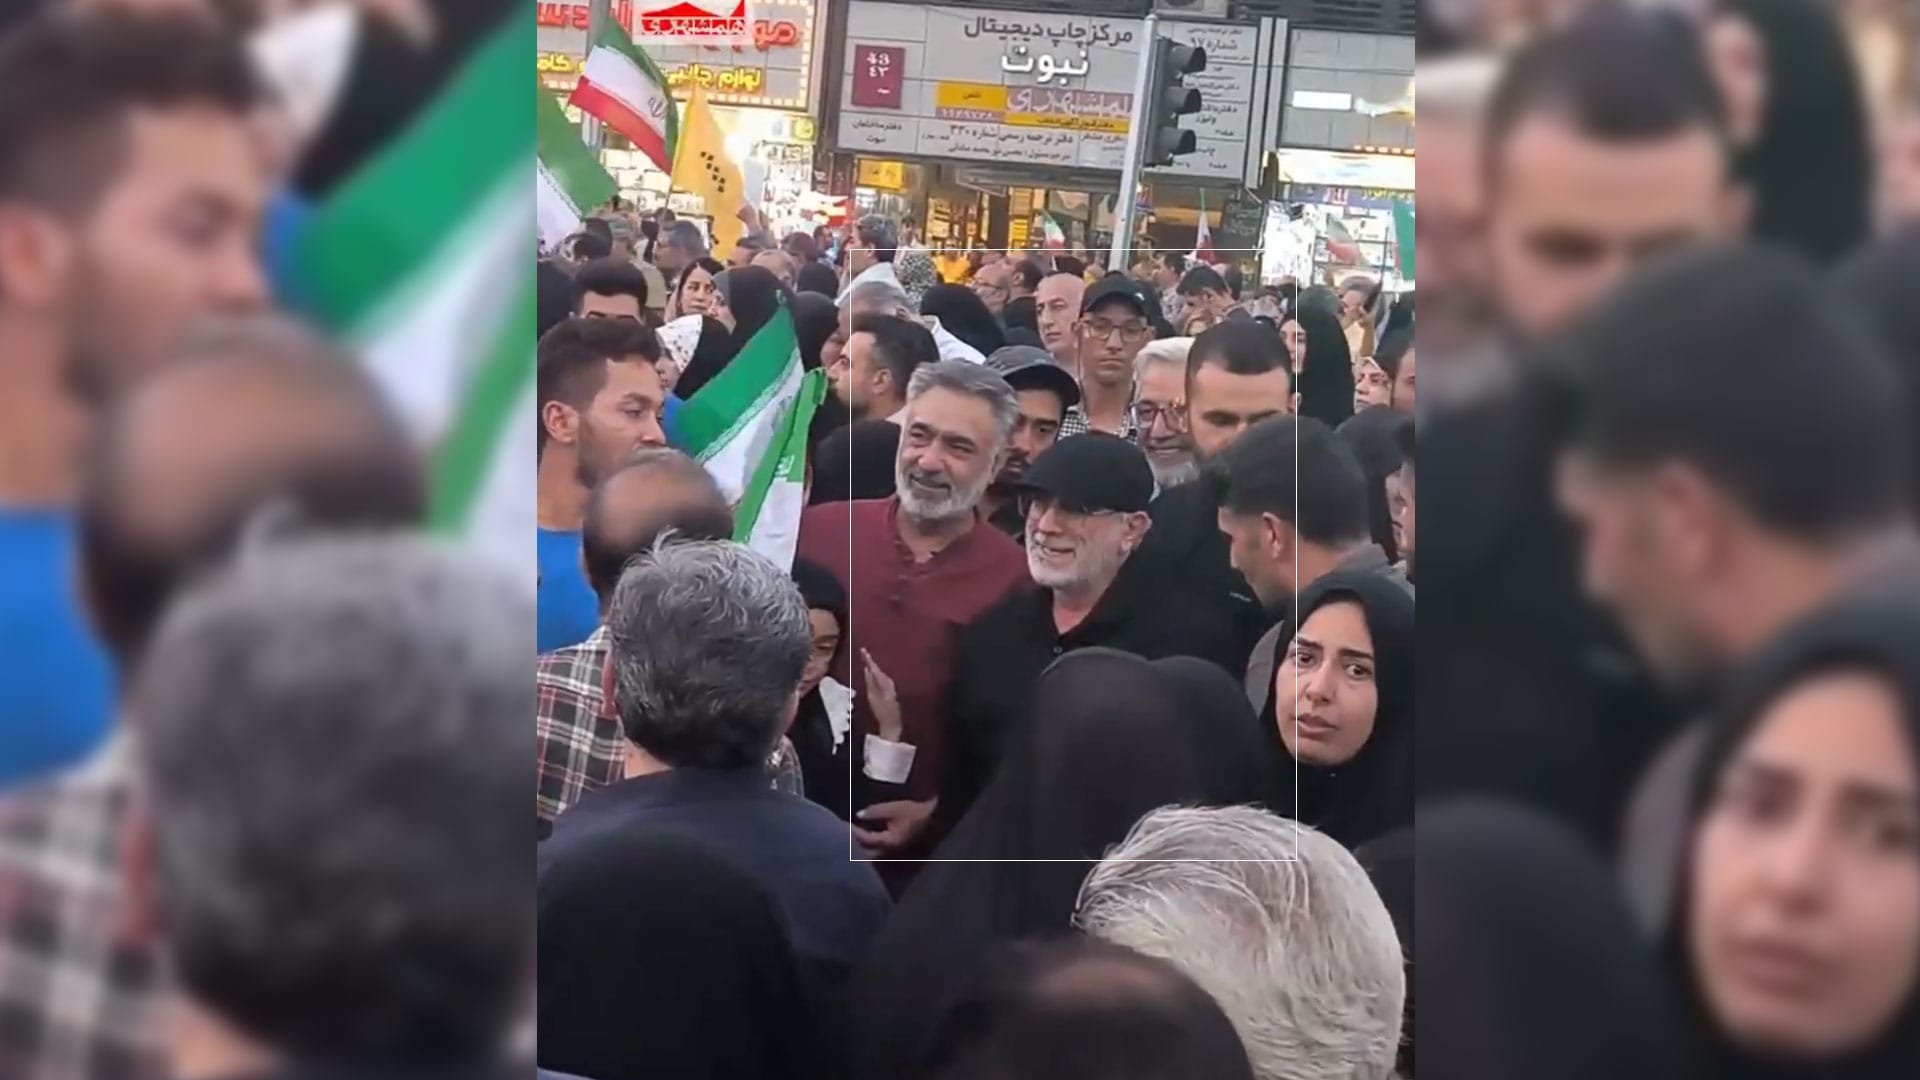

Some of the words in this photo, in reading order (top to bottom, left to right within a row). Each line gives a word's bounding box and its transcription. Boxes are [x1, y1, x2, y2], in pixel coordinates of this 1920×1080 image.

[965, 16, 1043, 41] دیجیتال
[1047, 22, 1087, 48] چاپ
[1084, 23, 1132, 46] مرکز
[1206, 39, 1238, 52] شماره
[866, 52, 890, 65] 43
[1002, 46, 1089, 84] نبوت
[719, 67, 762, 92] لوازم
[1006, 88, 1131, 117] مشهری
[972, 126, 998, 140] شماره
[998, 131, 1025, 144] رسمی
[1027, 132, 1052, 145] ترجمه
[1055, 134, 1073, 146] دفتر
